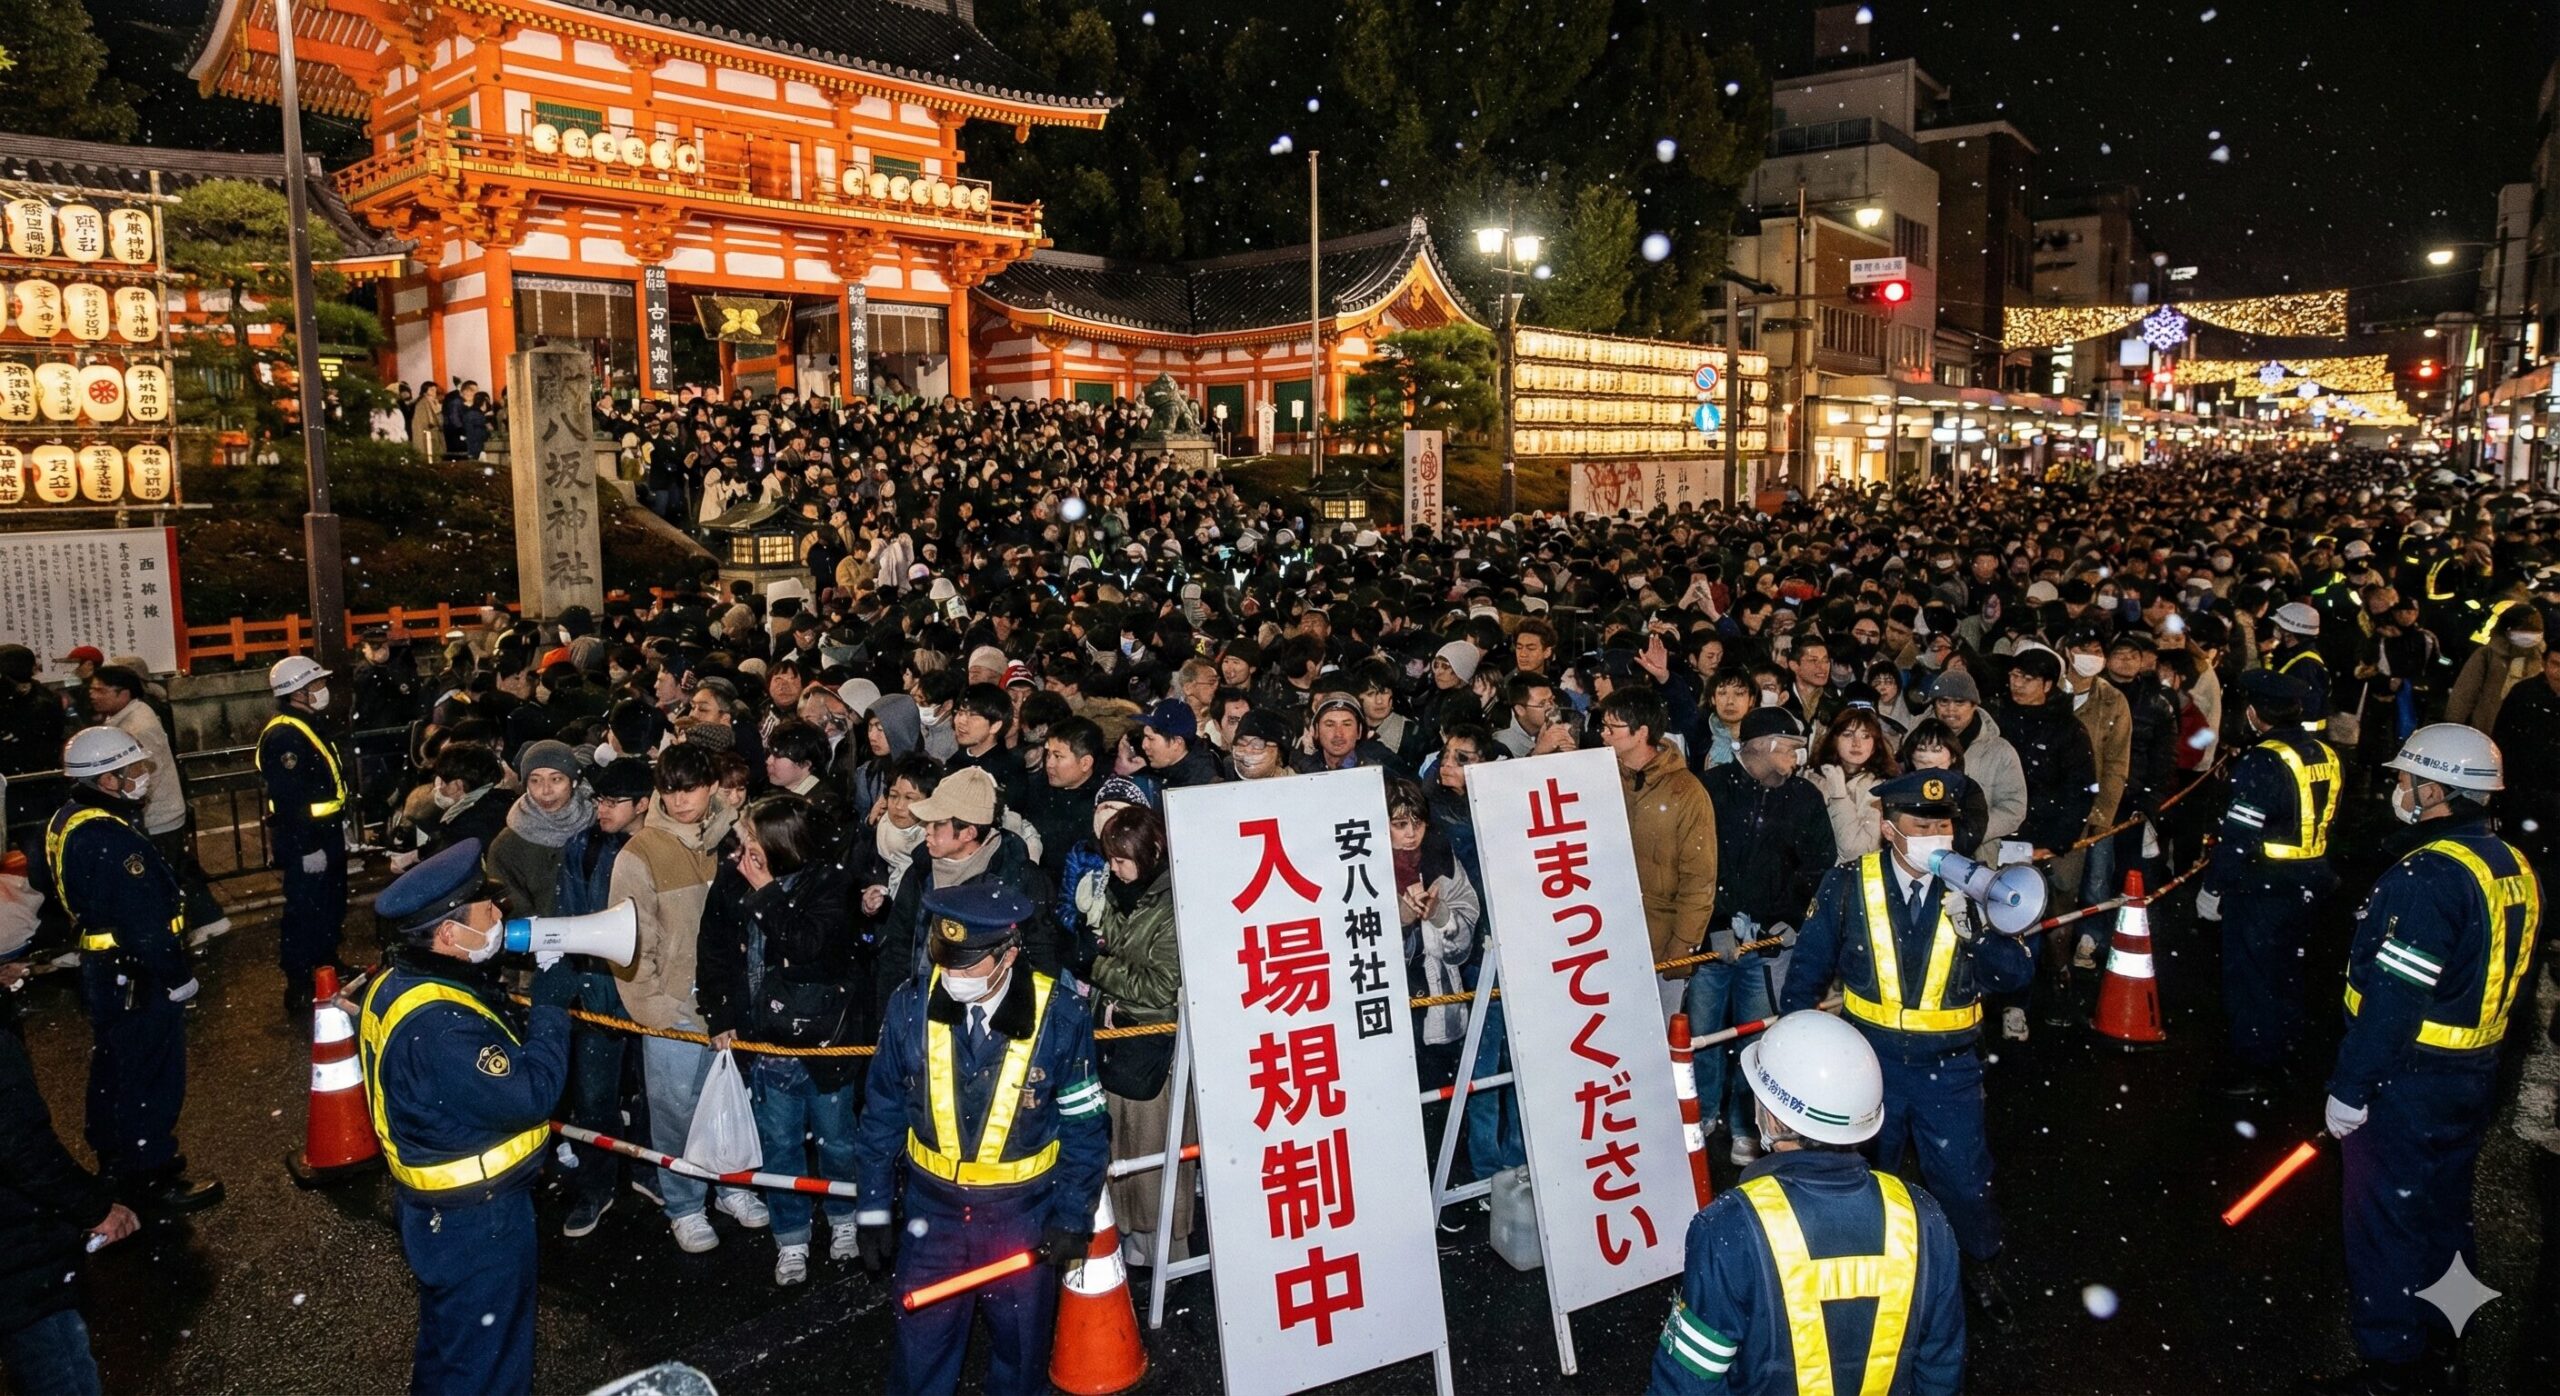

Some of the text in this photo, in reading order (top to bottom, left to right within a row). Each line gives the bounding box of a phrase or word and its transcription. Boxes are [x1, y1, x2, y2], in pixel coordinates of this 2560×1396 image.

[1232, 817, 1365, 1347] 入場規制中
[1333, 818, 1393, 1039] 安八神社団
[1526, 777, 1658, 1265] 止まってください
